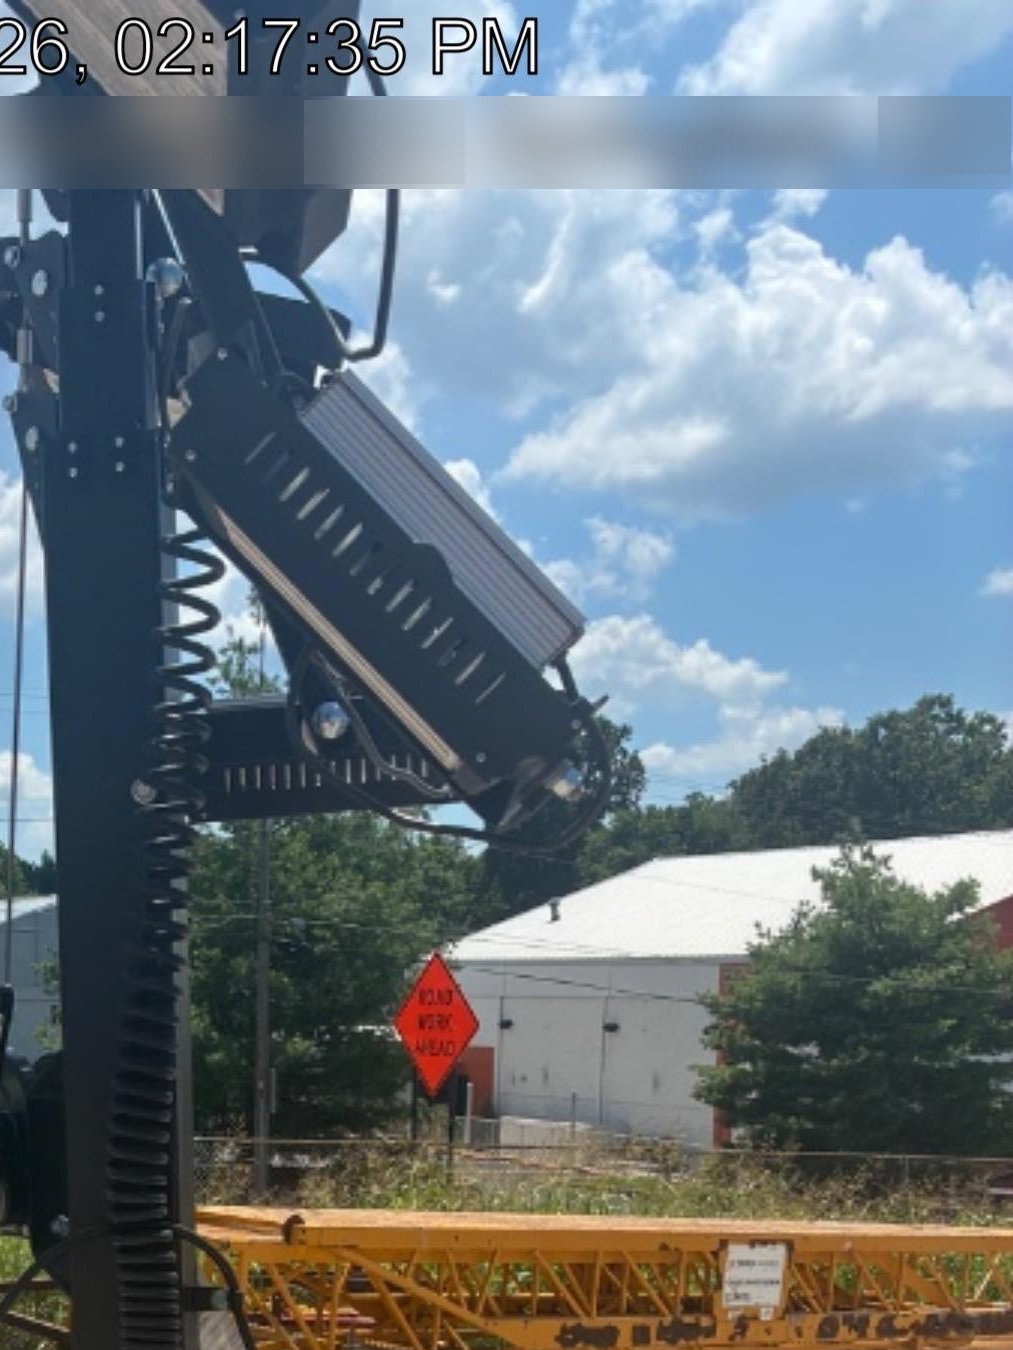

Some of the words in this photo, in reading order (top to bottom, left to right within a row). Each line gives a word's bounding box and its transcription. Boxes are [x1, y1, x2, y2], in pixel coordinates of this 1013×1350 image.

[418, 989, 453, 1006] ROAD
[418, 1013, 453, 1032] WORK
[415, 1038, 456, 1057] AHEAD
